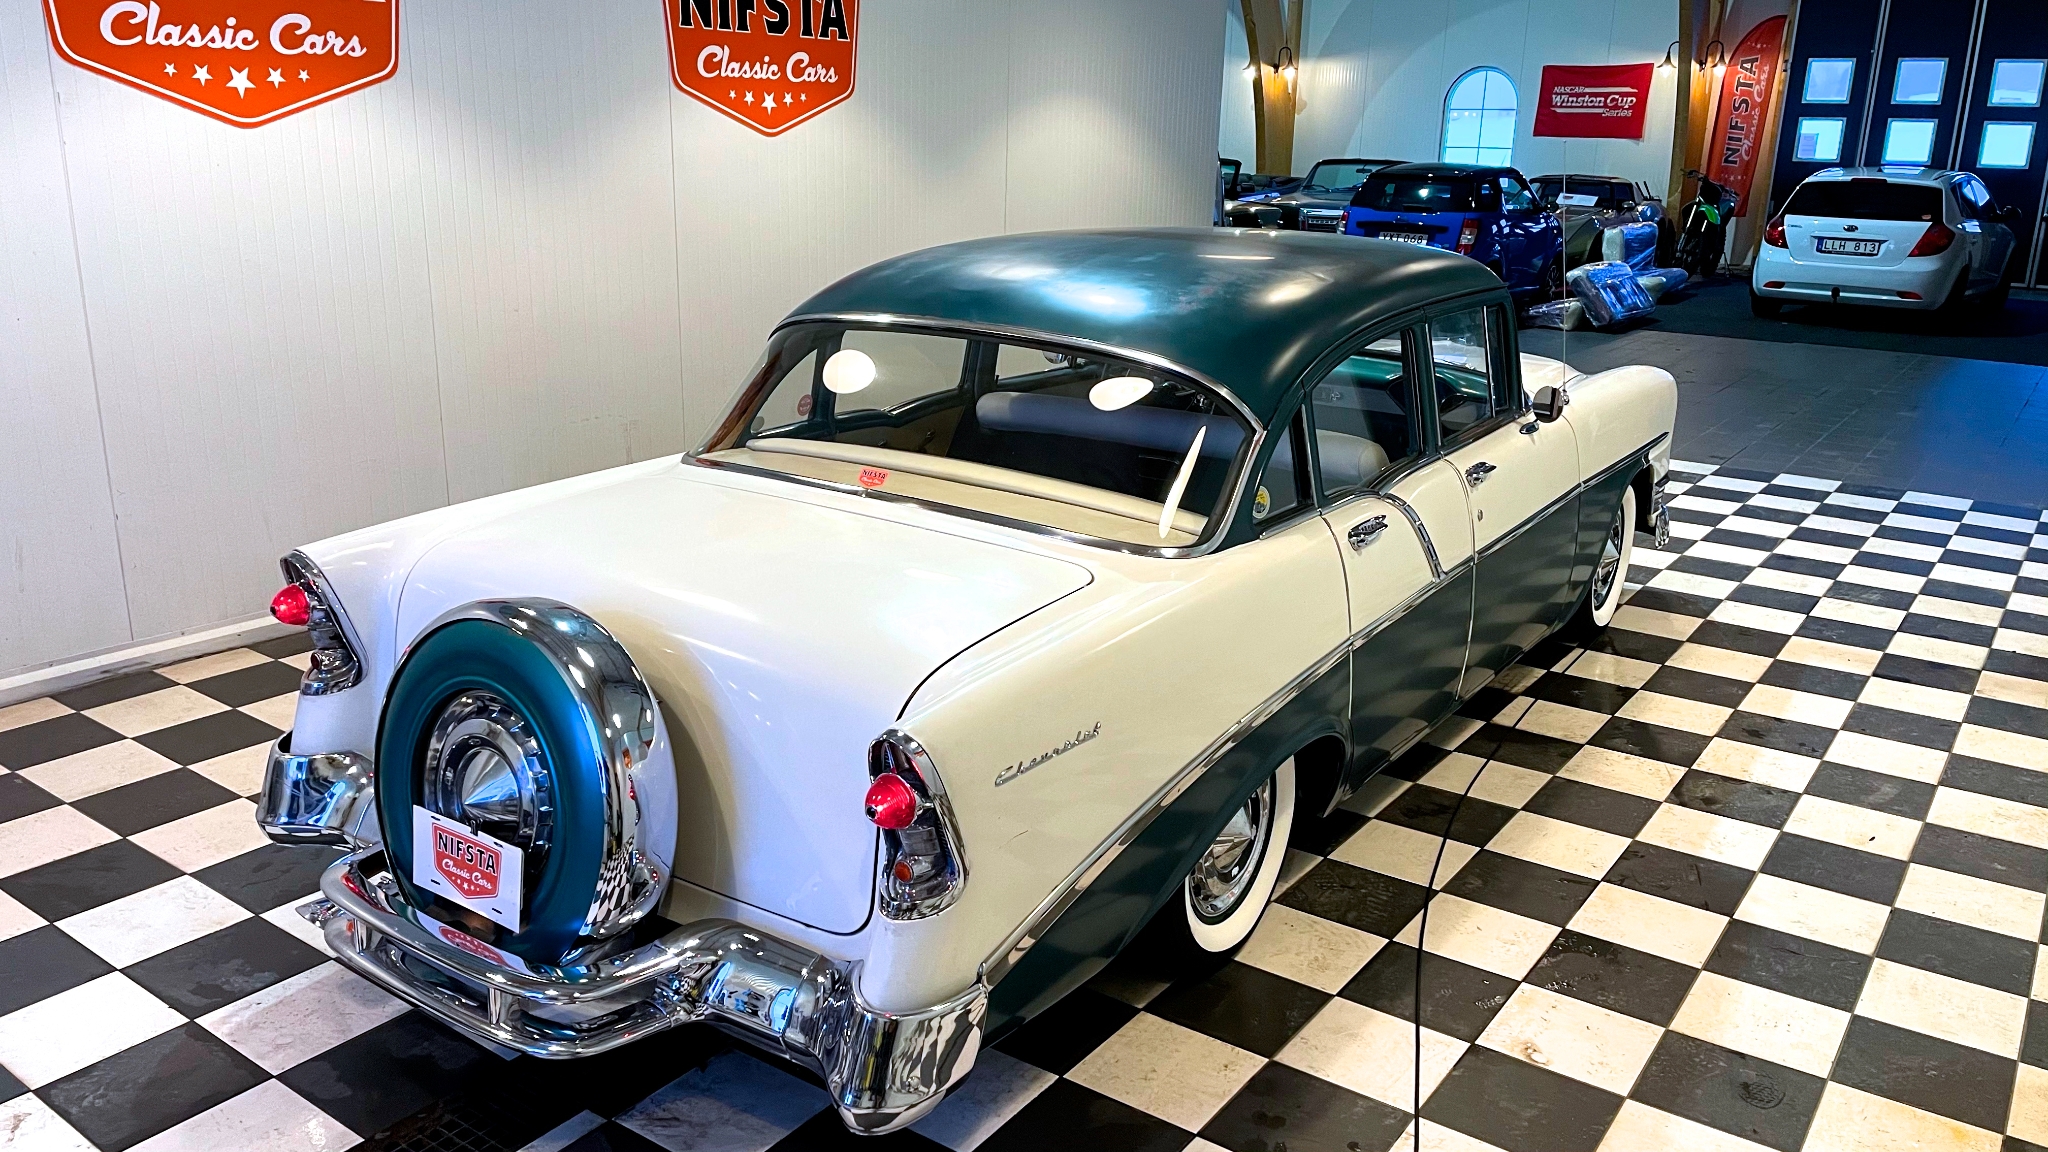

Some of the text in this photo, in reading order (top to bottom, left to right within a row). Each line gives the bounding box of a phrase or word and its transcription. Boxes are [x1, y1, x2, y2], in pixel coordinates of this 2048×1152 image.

[99, 0, 368, 58] Classic Cars
[678, 0, 851, 42] NIFSTA
[696, 44, 839, 84] Classic Cars
[1551, 94, 1637, 109] Winston Cup
[1601, 108, 1633, 117] Series
[1722, 55, 1760, 167] NIFSTA
[1742, 64, 1769, 160] Classic Cars
[1383, 233, 1424, 244] YXT 068
[1823, 240, 1877, 253] LLH 813
[994, 720, 1102, 788] Chevrolet
[438, 832, 497, 875] NIFSTA
[442, 859, 492, 890] Classic Cars
